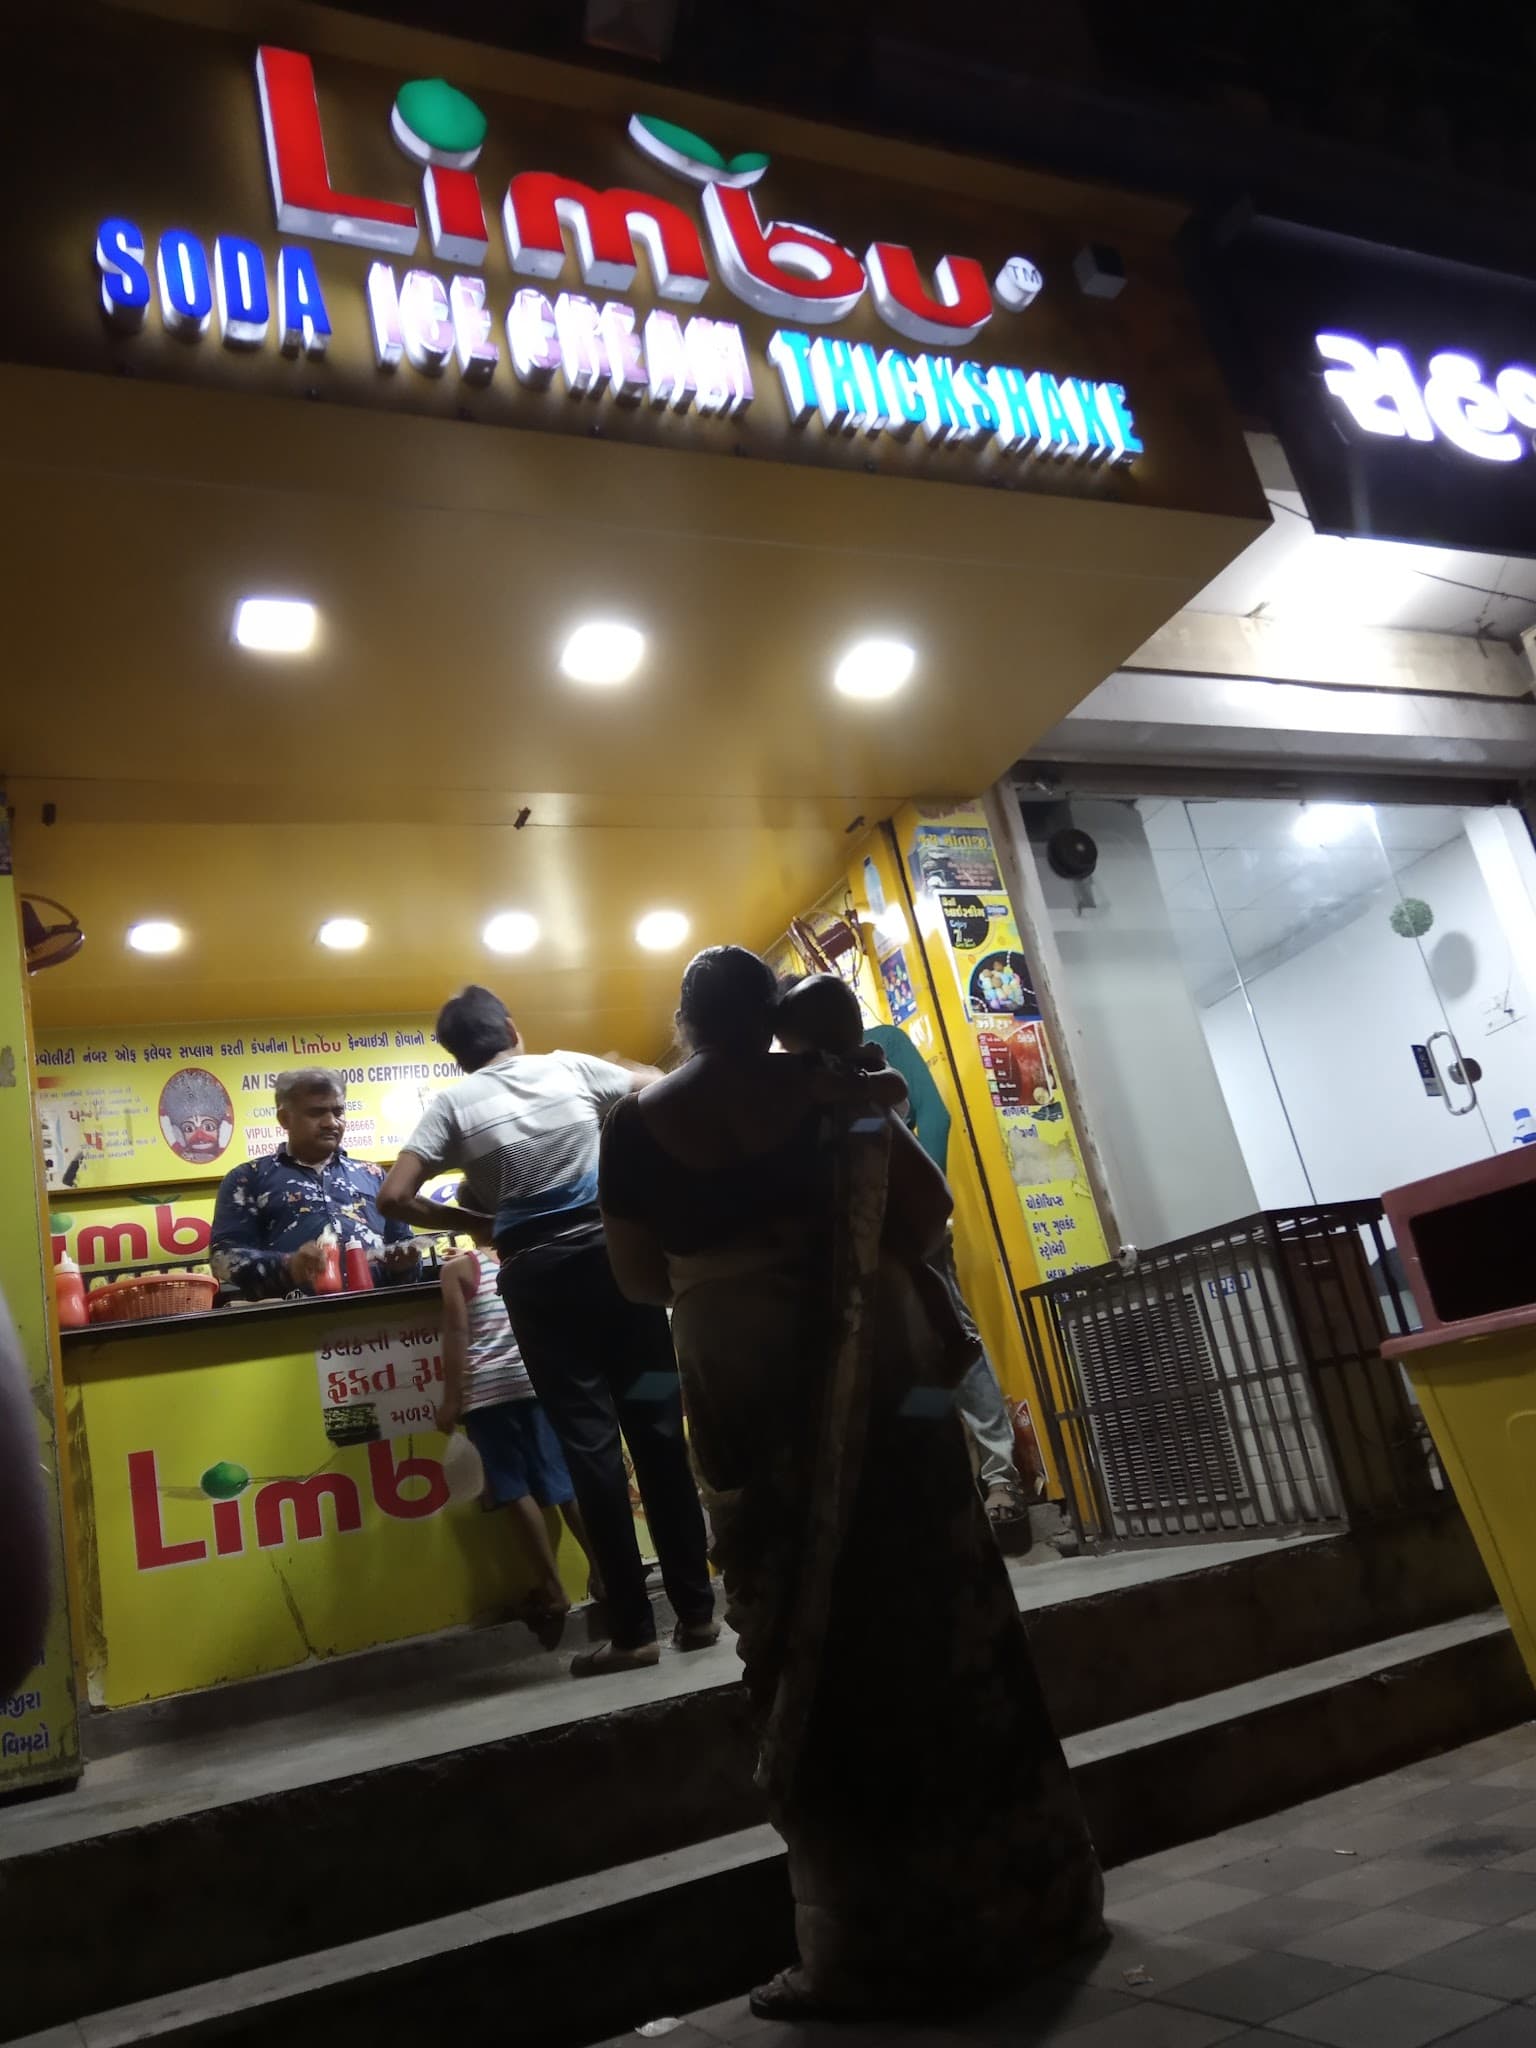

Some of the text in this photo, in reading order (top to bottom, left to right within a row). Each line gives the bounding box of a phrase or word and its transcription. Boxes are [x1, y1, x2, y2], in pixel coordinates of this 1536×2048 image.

[256, 46, 993, 345] Limbu
[97, 218, 1144, 468] SODA ICE CREAM THICKSHAKE
[36, 1047, 75, 1066] વોલીટી
[82, 1046, 108, 1063] નંબર
[114, 1041, 137, 1063] ઓફ
[220, 1039, 244, 1056] કરતી
[251, 1037, 288, 1054] કંપનીના
[292, 1033, 342, 1055] Limbu
[395, 1030, 424, 1047] હોવાનો
[242, 1075, 260, 1091] AN
[341, 1069, 364, 1084] 008
[368, 1064, 430, 1083] CERTIFIED
[253, 1107, 277, 1118] CONT
[245, 1128, 272, 1140] VIPUL
[275, 1125, 289, 1137] RA
[342, 1136, 373, 1148] 555068
[51, 1205, 212, 1266] imb
[1032, 1215, 1076, 1237] કાજુ ગુલકંદ
[128, 1439, 452, 1570] Limb
[0, 1691, 41, 1718] જીરા
